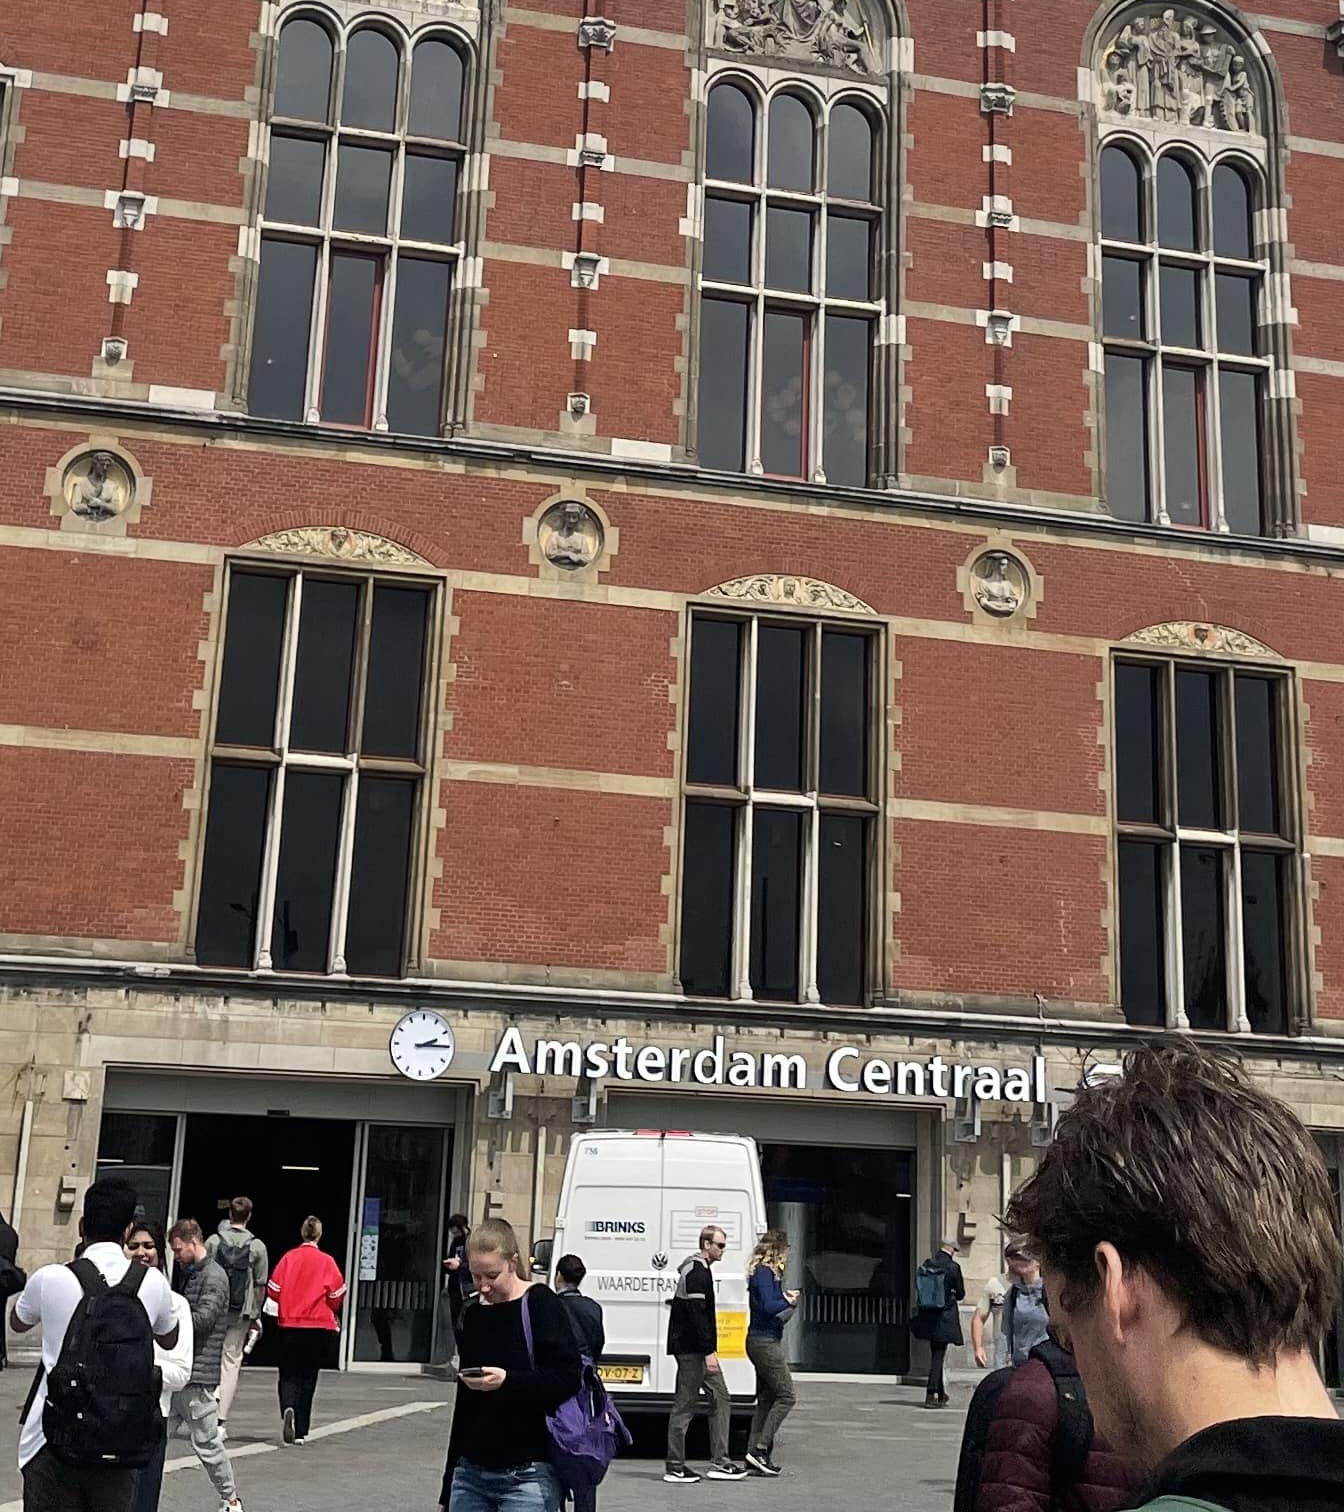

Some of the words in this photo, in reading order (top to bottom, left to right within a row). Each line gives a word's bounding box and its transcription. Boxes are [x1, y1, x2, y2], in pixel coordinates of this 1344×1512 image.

[490, 1026, 808, 1090] Amsterdam
[828, 1046, 1048, 1104] Centraal
[595, 1221, 646, 1234] BRINKS
